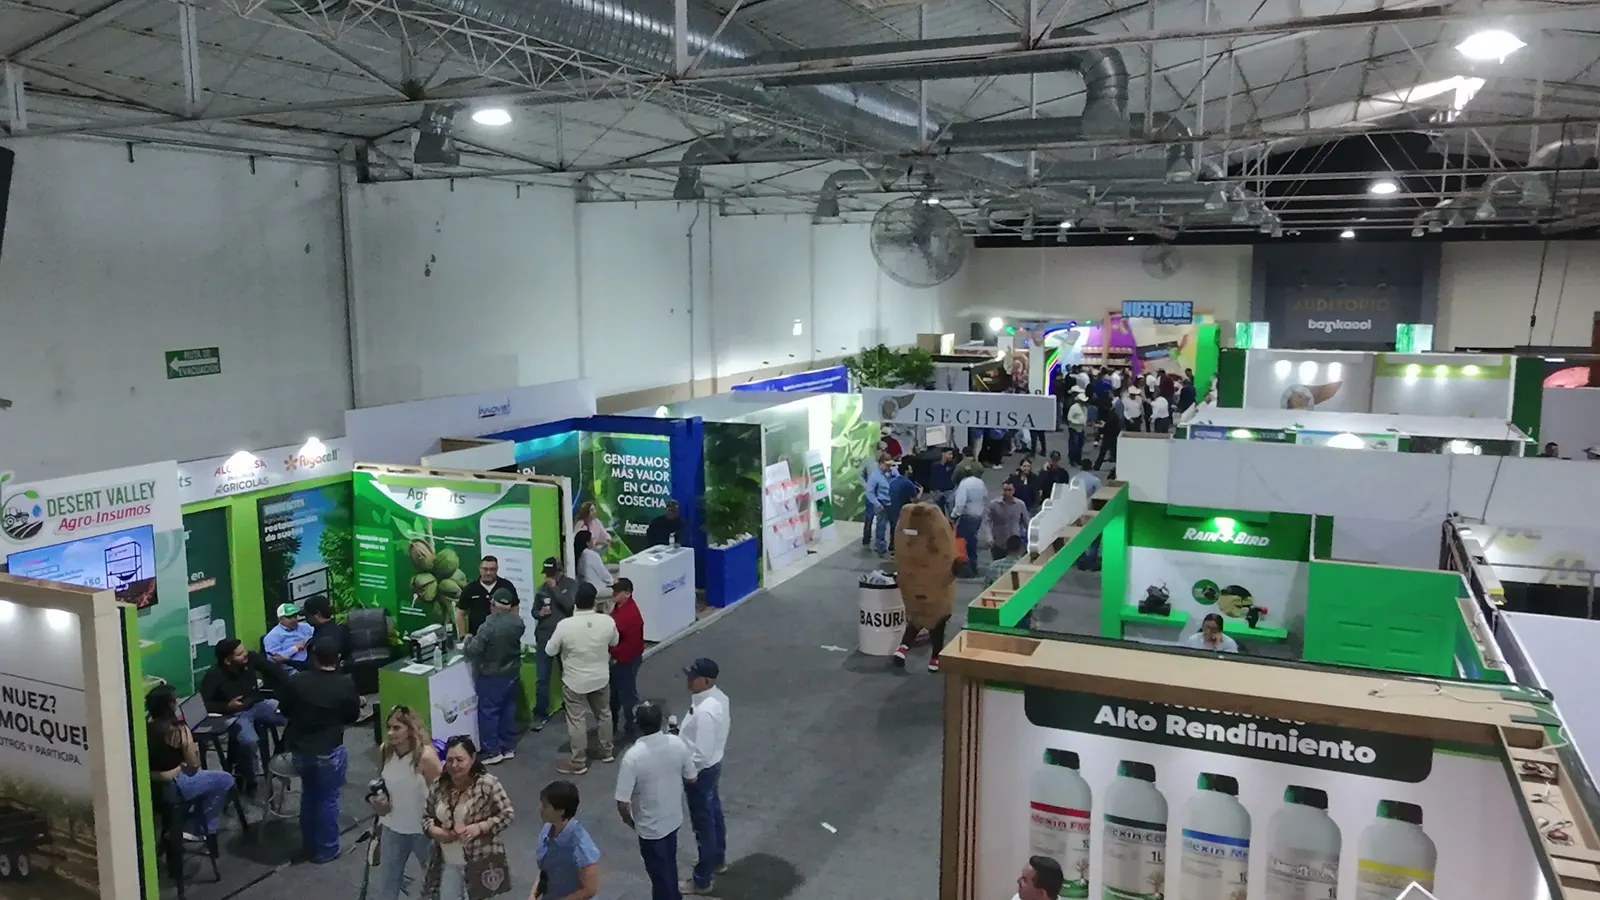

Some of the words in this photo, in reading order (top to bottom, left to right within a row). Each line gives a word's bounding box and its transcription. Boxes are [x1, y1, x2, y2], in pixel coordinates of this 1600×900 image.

[914, 407, 1036, 428] ISECHISA
[604, 453, 670, 468] GENERAMOS
[611, 466, 634, 479] MÁS
[636, 470, 670, 482] VALOR
[623, 483, 638, 493] EN
[639, 484, 670, 496] CADA
[47, 490, 102, 518] DESERT
[106, 481, 156, 507] VALLEY
[617, 494, 667, 509] COSECHA
[58, 503, 151, 531] Agro-Insumos
[1232, 531, 1270, 546] BIRD
[191, 571, 204, 581] en
[2, 686, 57, 714] NUEZ?
[1093, 705, 1158, 732] Alto
[1165, 714, 1377, 765] Rendimiento
[1151, 851, 1162, 862] 1L
